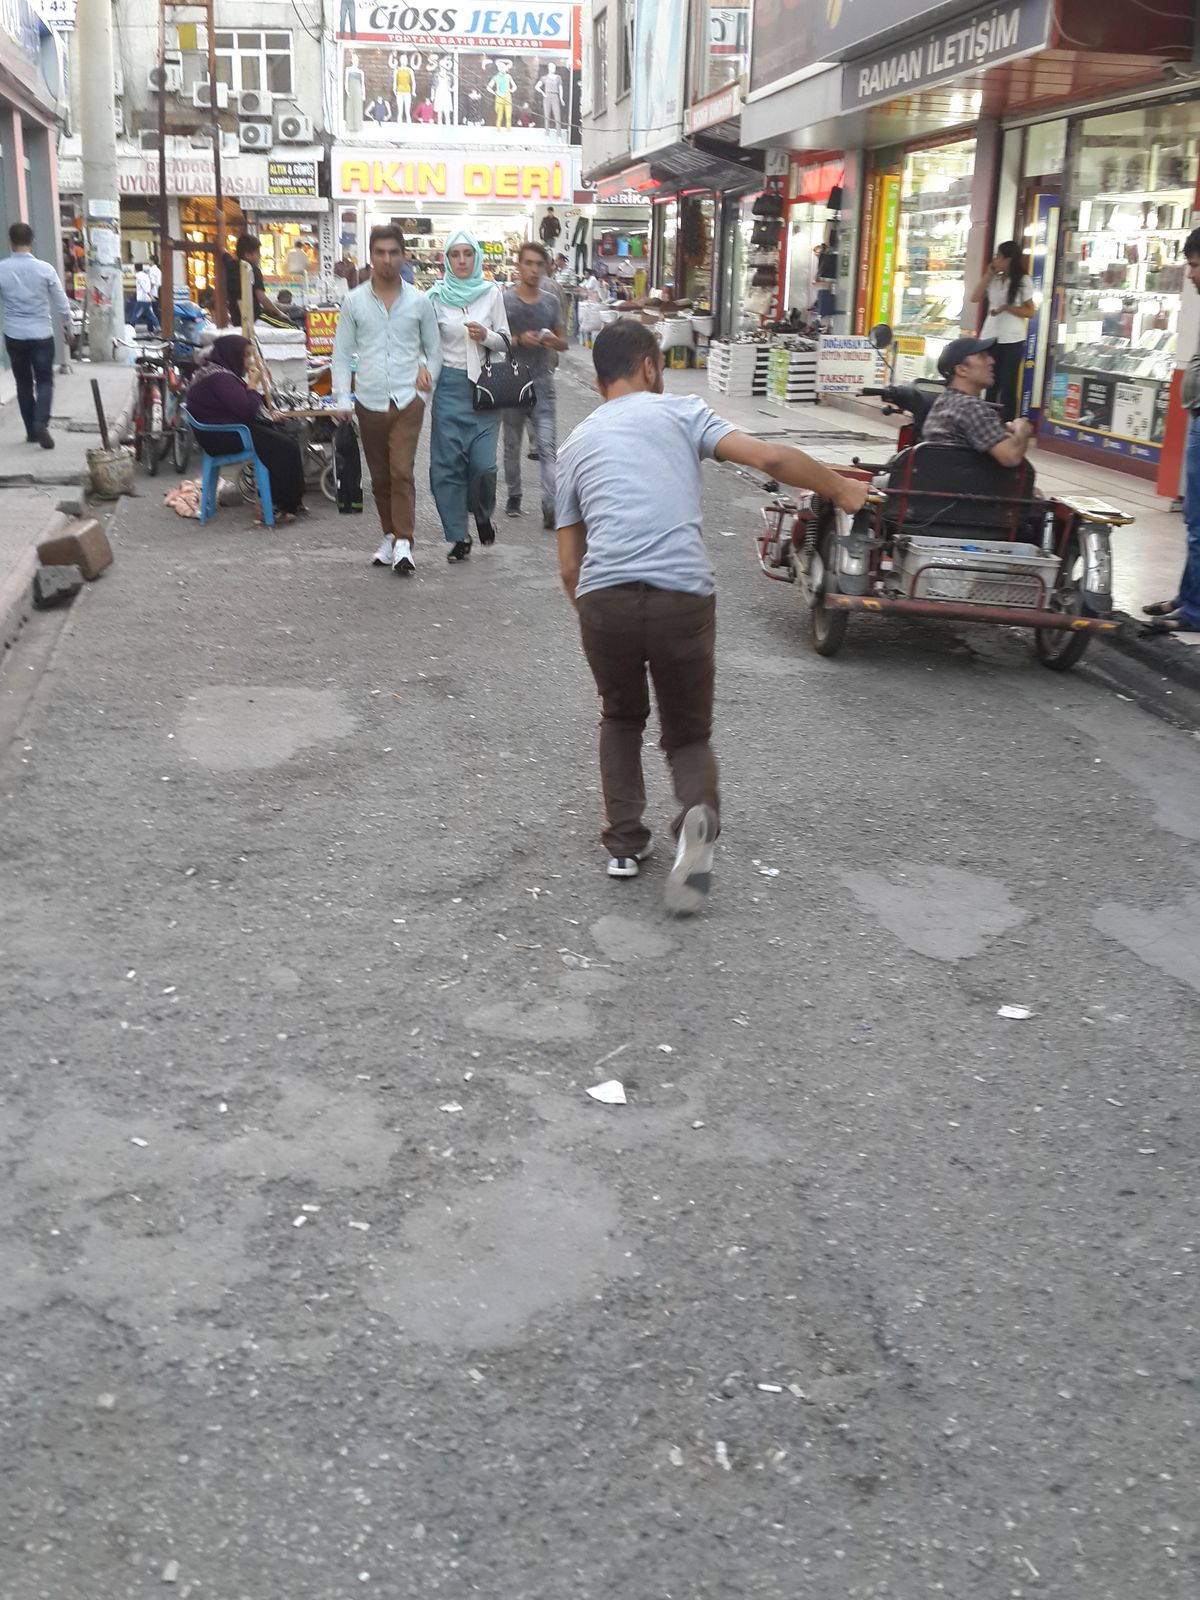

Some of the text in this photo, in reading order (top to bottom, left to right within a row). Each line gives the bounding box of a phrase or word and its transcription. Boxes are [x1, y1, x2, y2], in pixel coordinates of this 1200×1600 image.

[464, 10, 563, 37] JEANS
[857, 8, 1021, 98] RAMAN İLETİŞİM
[342, 161, 563, 199] AKIN DERİ
[592, 191, 651, 204] FABRİKA
